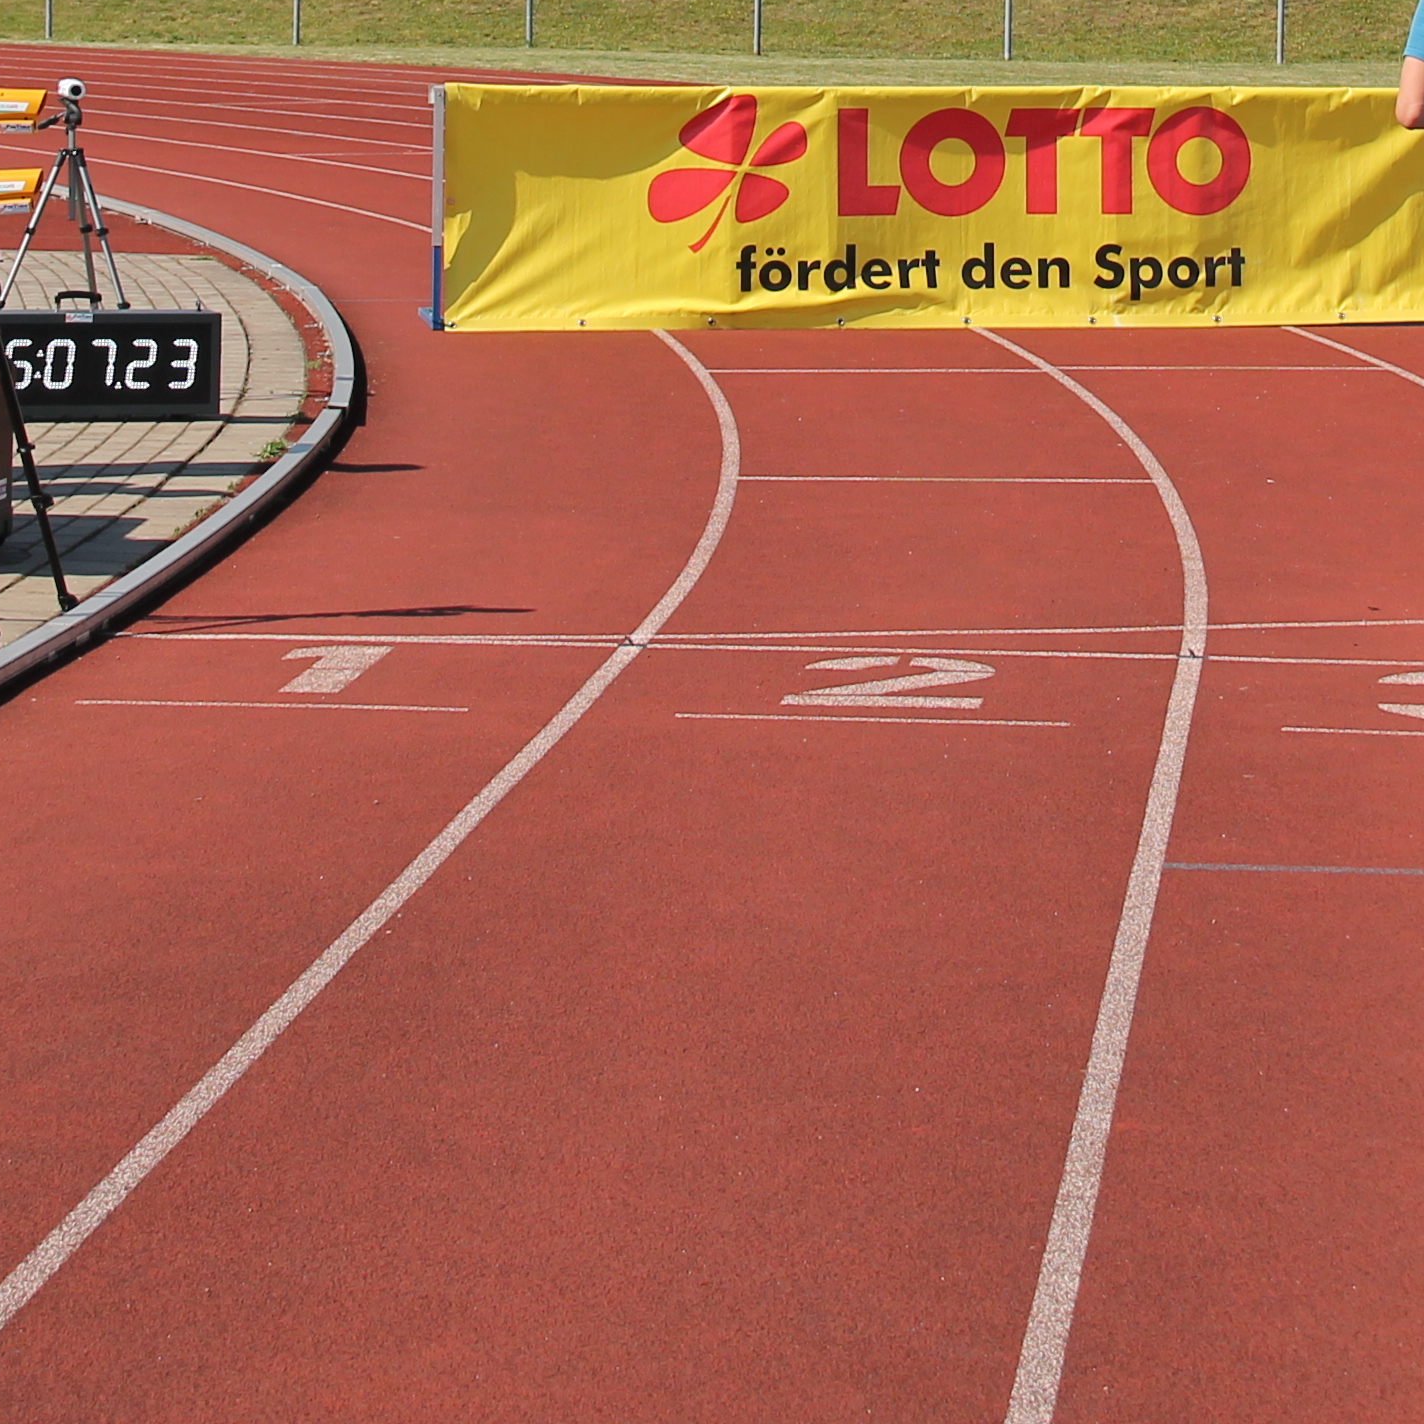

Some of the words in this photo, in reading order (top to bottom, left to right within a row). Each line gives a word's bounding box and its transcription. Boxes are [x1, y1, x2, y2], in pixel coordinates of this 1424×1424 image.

[838, 106, 1252, 217] LOTTO
[736, 244, 940, 292] fördert
[962, 242, 1070, 290] den
[1094, 244, 1246, 302] Sport
[279, 645, 395, 694] 1
[779, 655, 997, 710] 2
